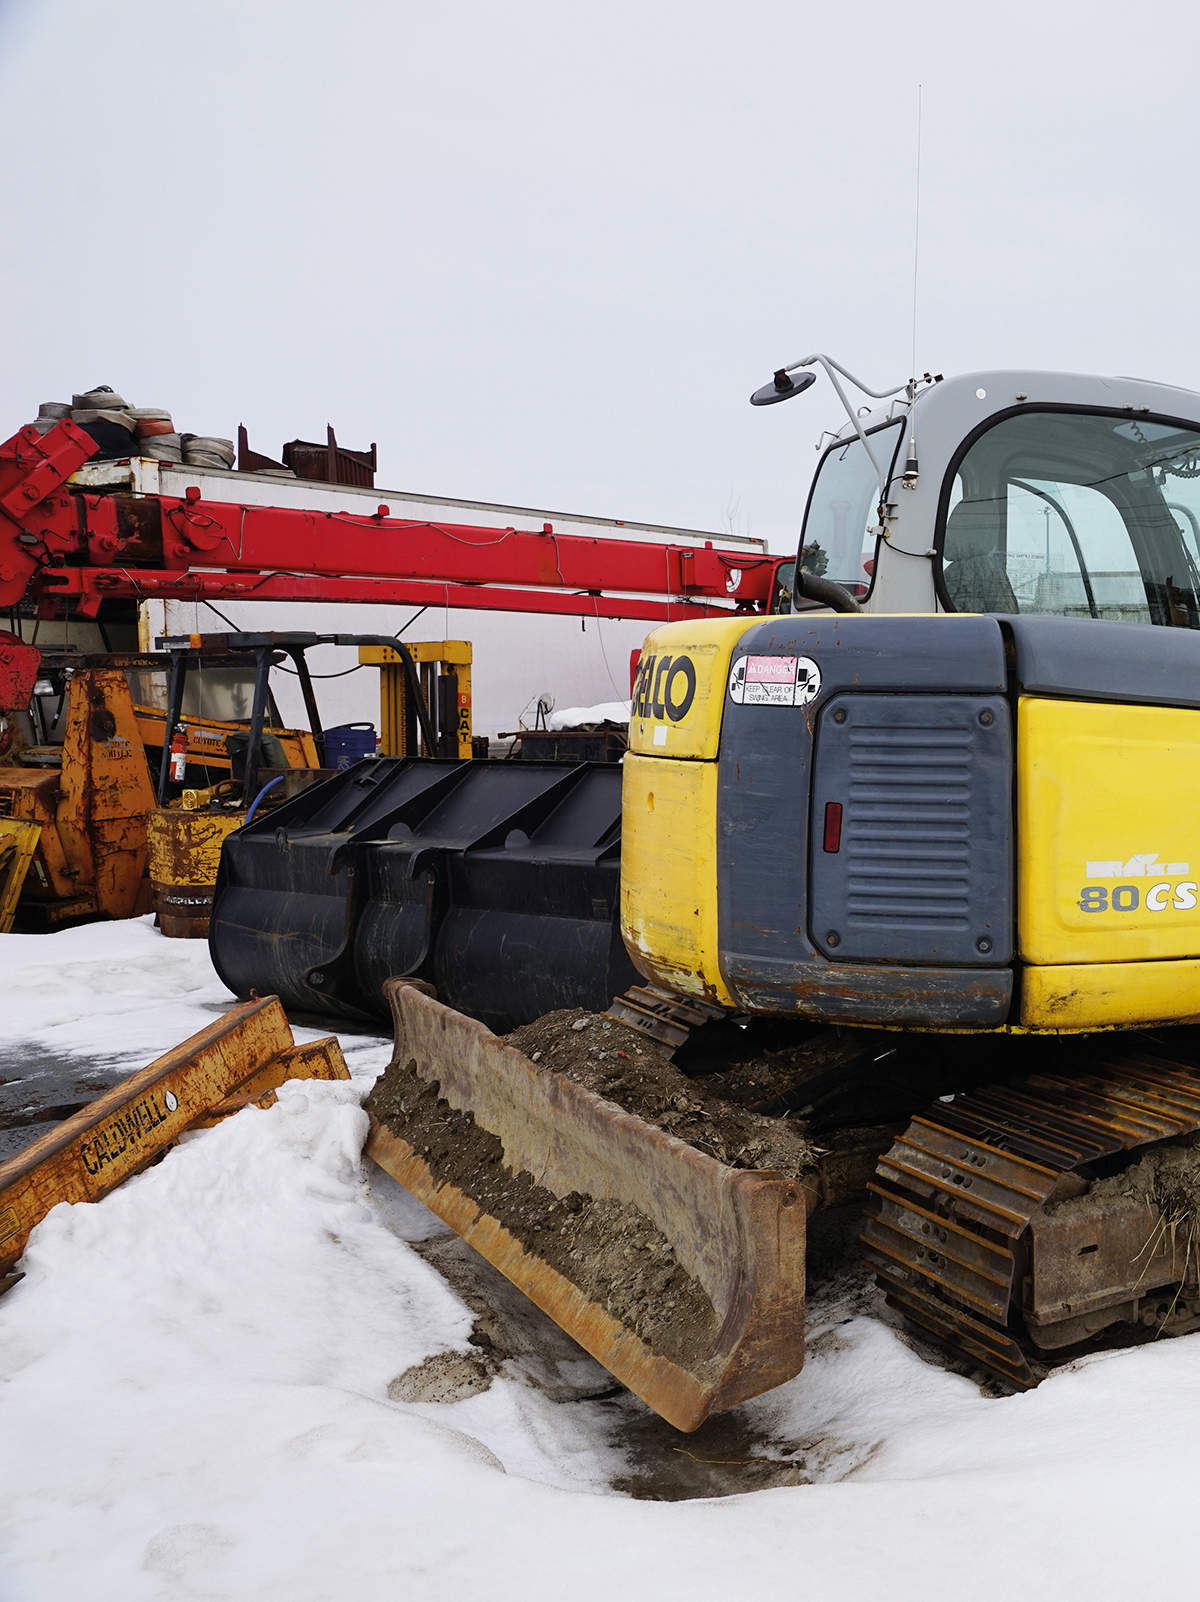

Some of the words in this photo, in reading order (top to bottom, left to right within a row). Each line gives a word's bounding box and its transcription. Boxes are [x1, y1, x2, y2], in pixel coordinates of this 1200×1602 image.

[757, 664, 795, 675] DANGER
[746, 685, 760, 693] KEEP
[763, 685, 782, 693] CLEAR
[461, 695, 467, 704] 8
[749, 694, 768, 702] SWING
[460, 708, 470, 742] CAT
[80, 1095, 167, 1175] CALDWELL
